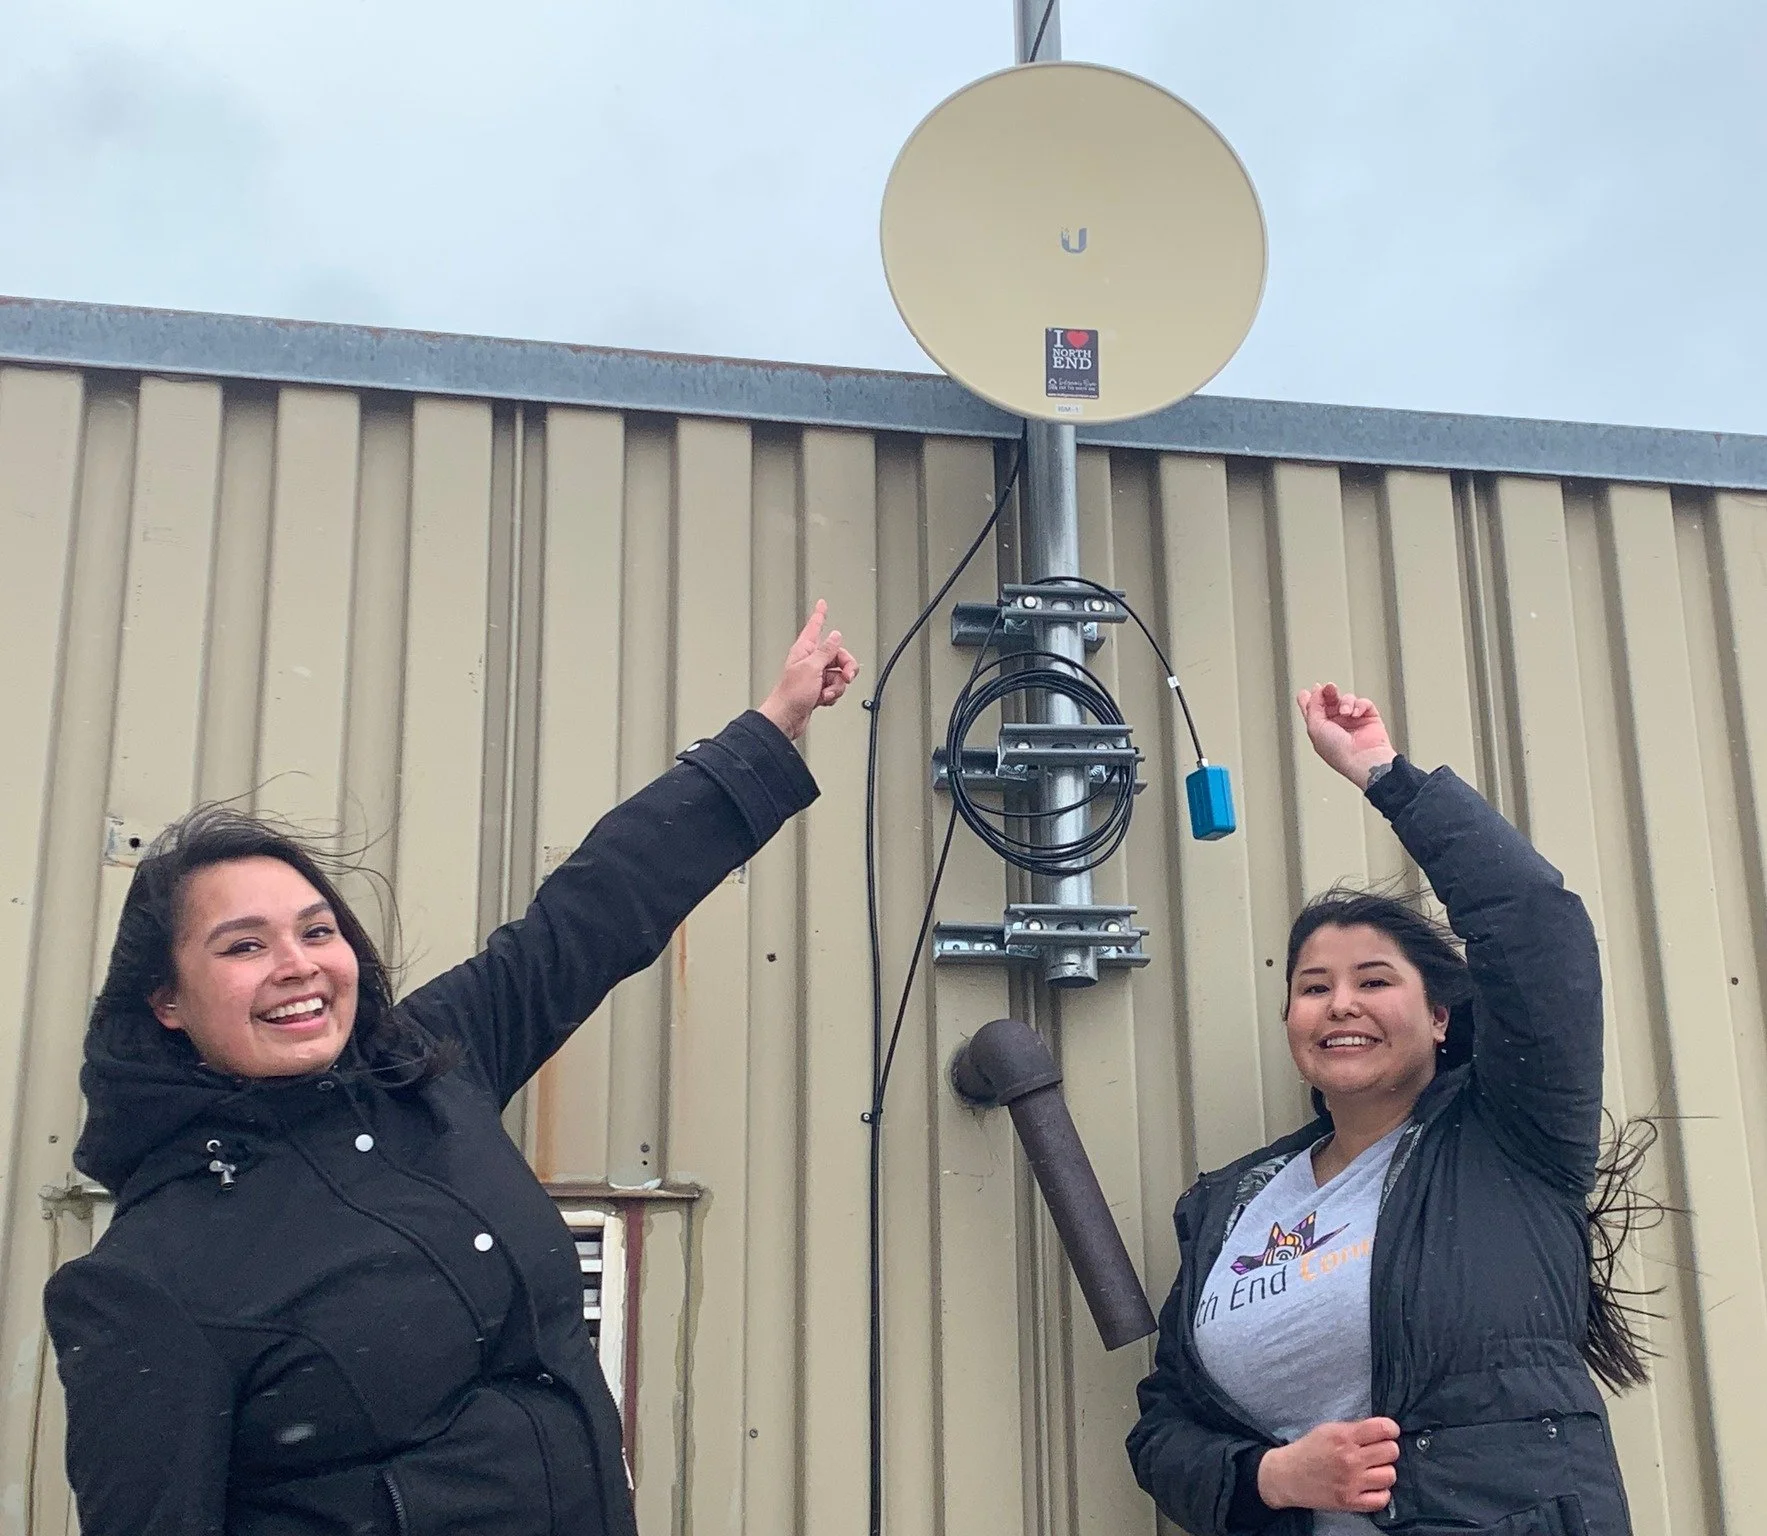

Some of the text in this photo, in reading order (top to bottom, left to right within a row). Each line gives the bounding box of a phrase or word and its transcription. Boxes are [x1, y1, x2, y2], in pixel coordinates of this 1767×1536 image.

[1053, 329, 1064, 348] I
[1052, 348, 1092, 359] NORTH
[1052, 356, 1092, 370] END
[1230, 1264, 1288, 1311] End
